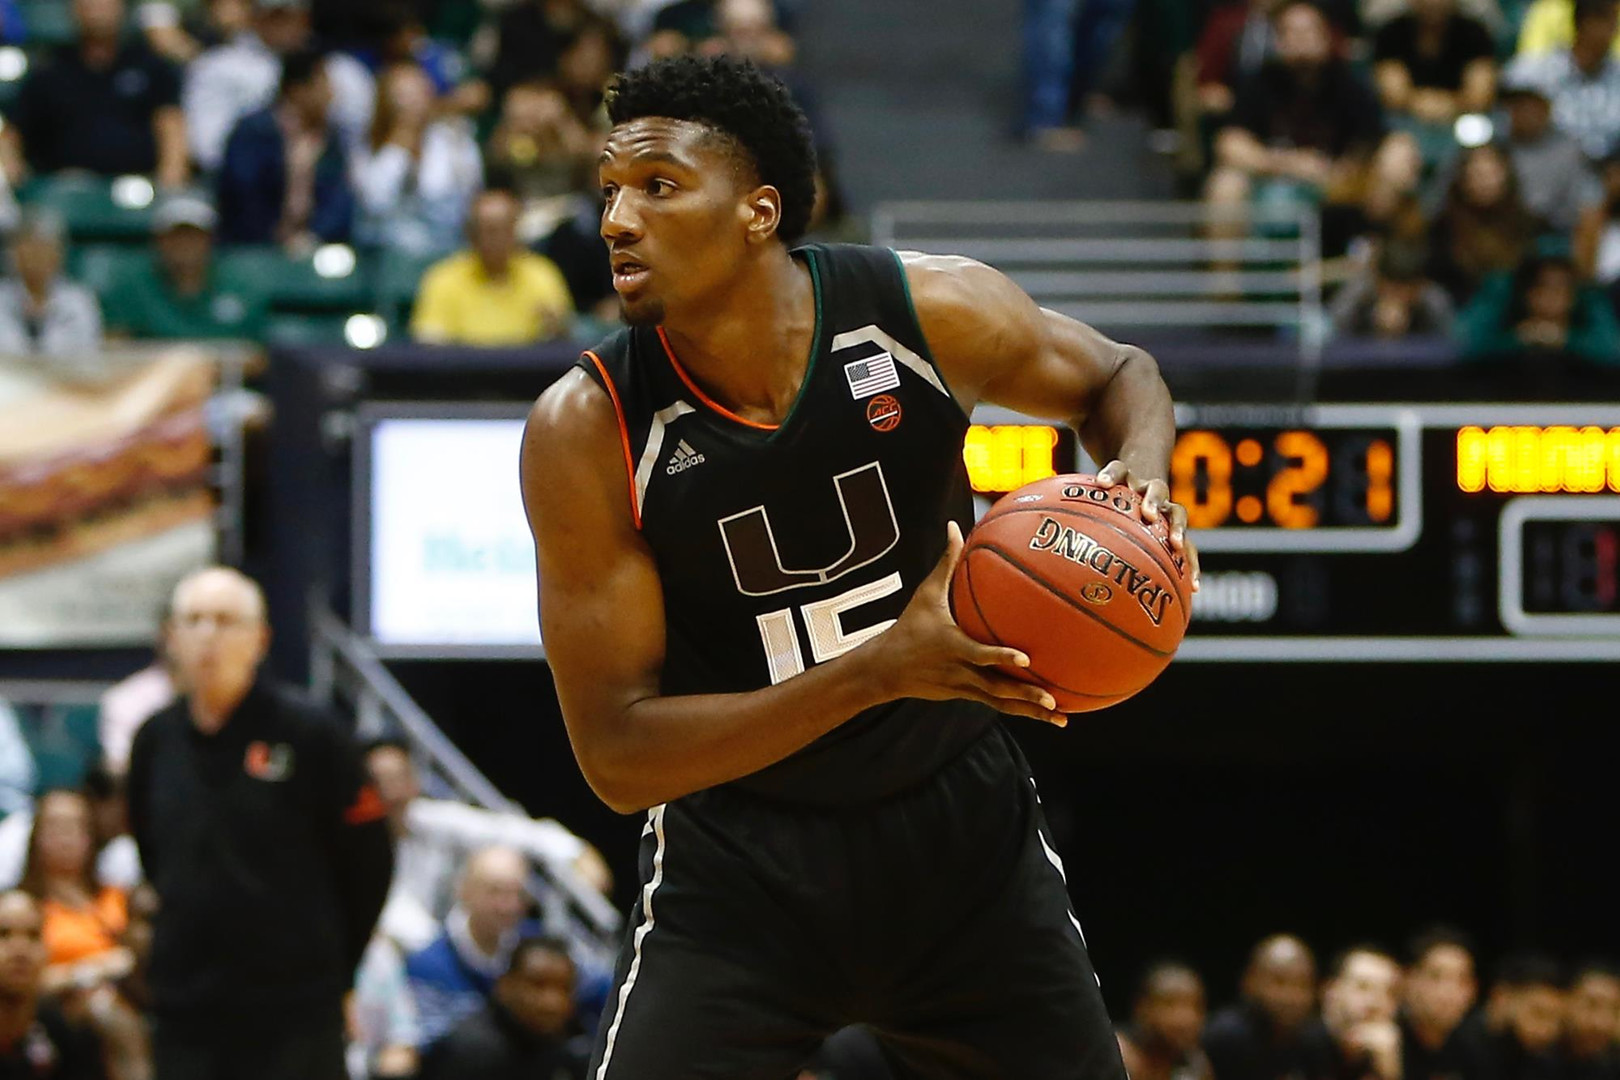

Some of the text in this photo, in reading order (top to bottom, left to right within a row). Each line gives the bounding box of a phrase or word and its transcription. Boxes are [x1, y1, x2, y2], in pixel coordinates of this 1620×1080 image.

[666, 453, 705, 475] adidas
[718, 461, 900, 596] U
[1029, 516, 1173, 627] SPALDING
